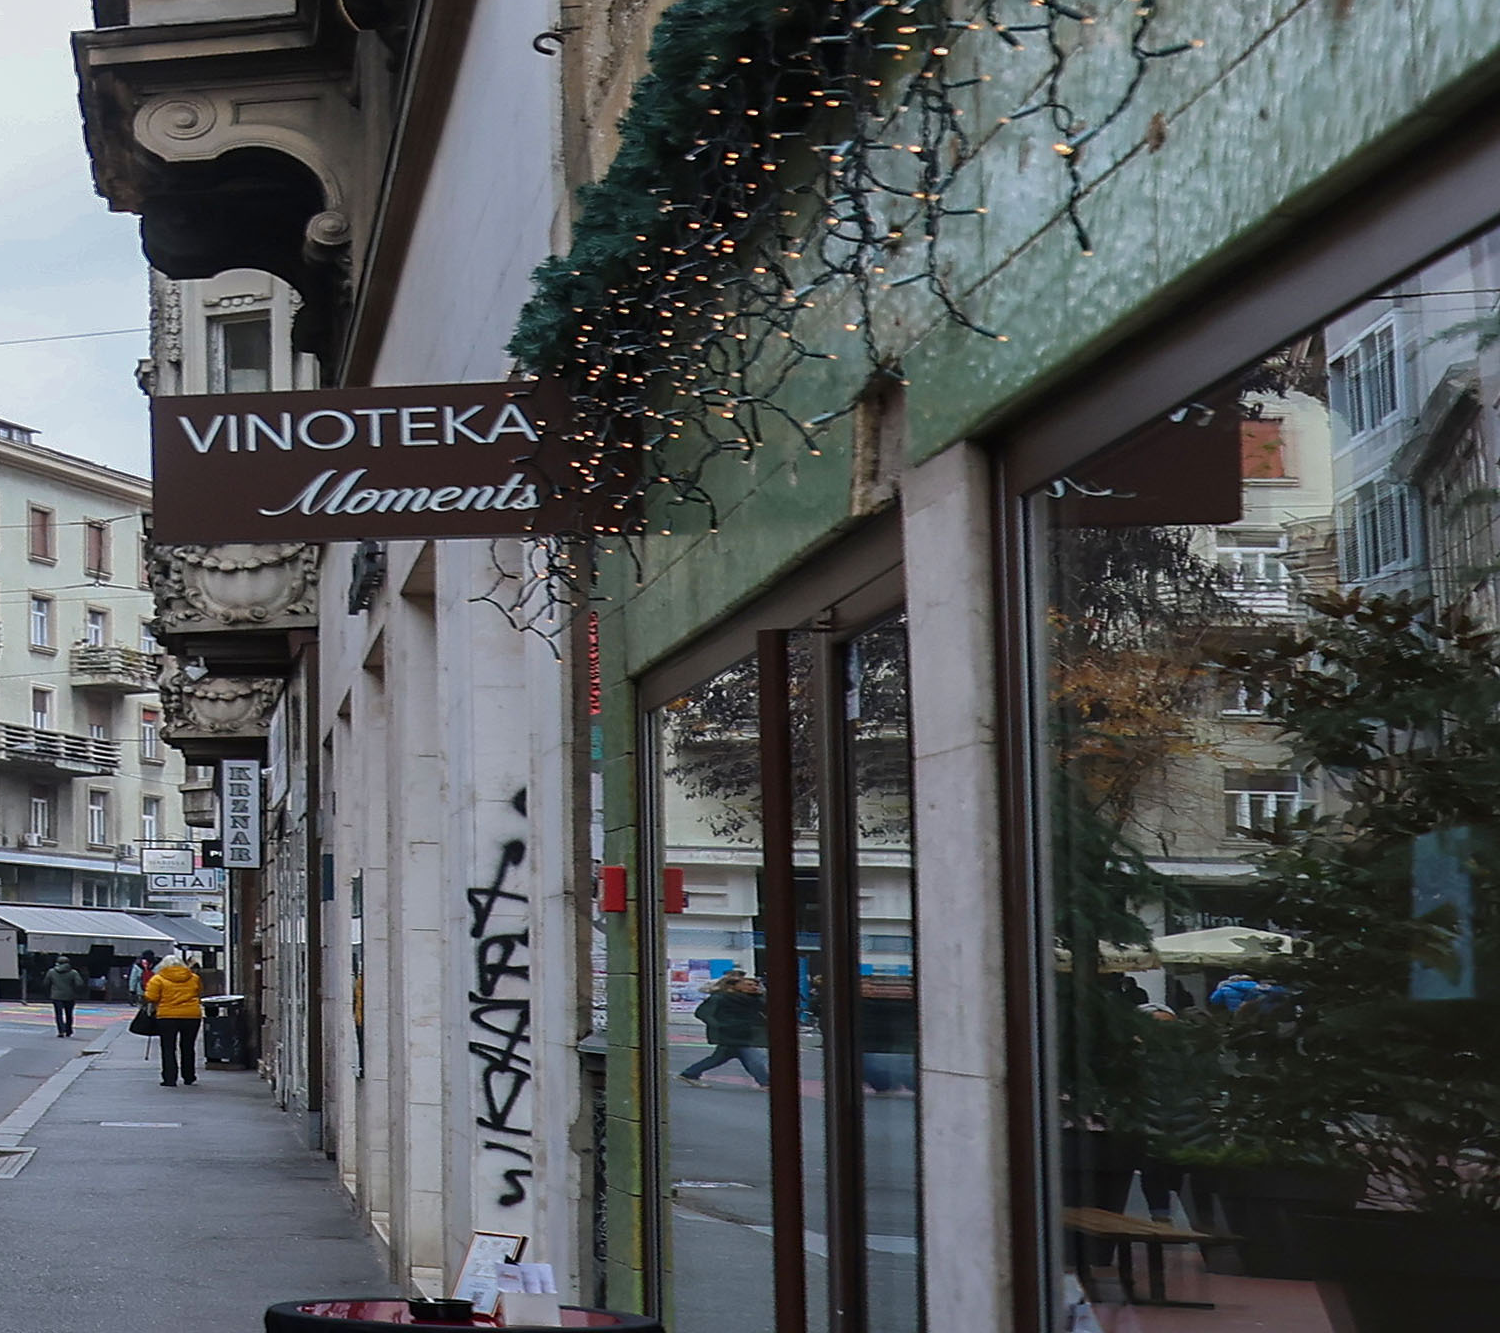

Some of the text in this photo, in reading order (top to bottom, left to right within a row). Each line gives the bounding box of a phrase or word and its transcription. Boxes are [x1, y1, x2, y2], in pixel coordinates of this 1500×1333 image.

[178, 403, 540, 454] VINOTEKA
[258, 468, 541, 517] Moments
[228, 766, 253, 863] KRZNAR
[153, 875, 213, 888] CHAI
